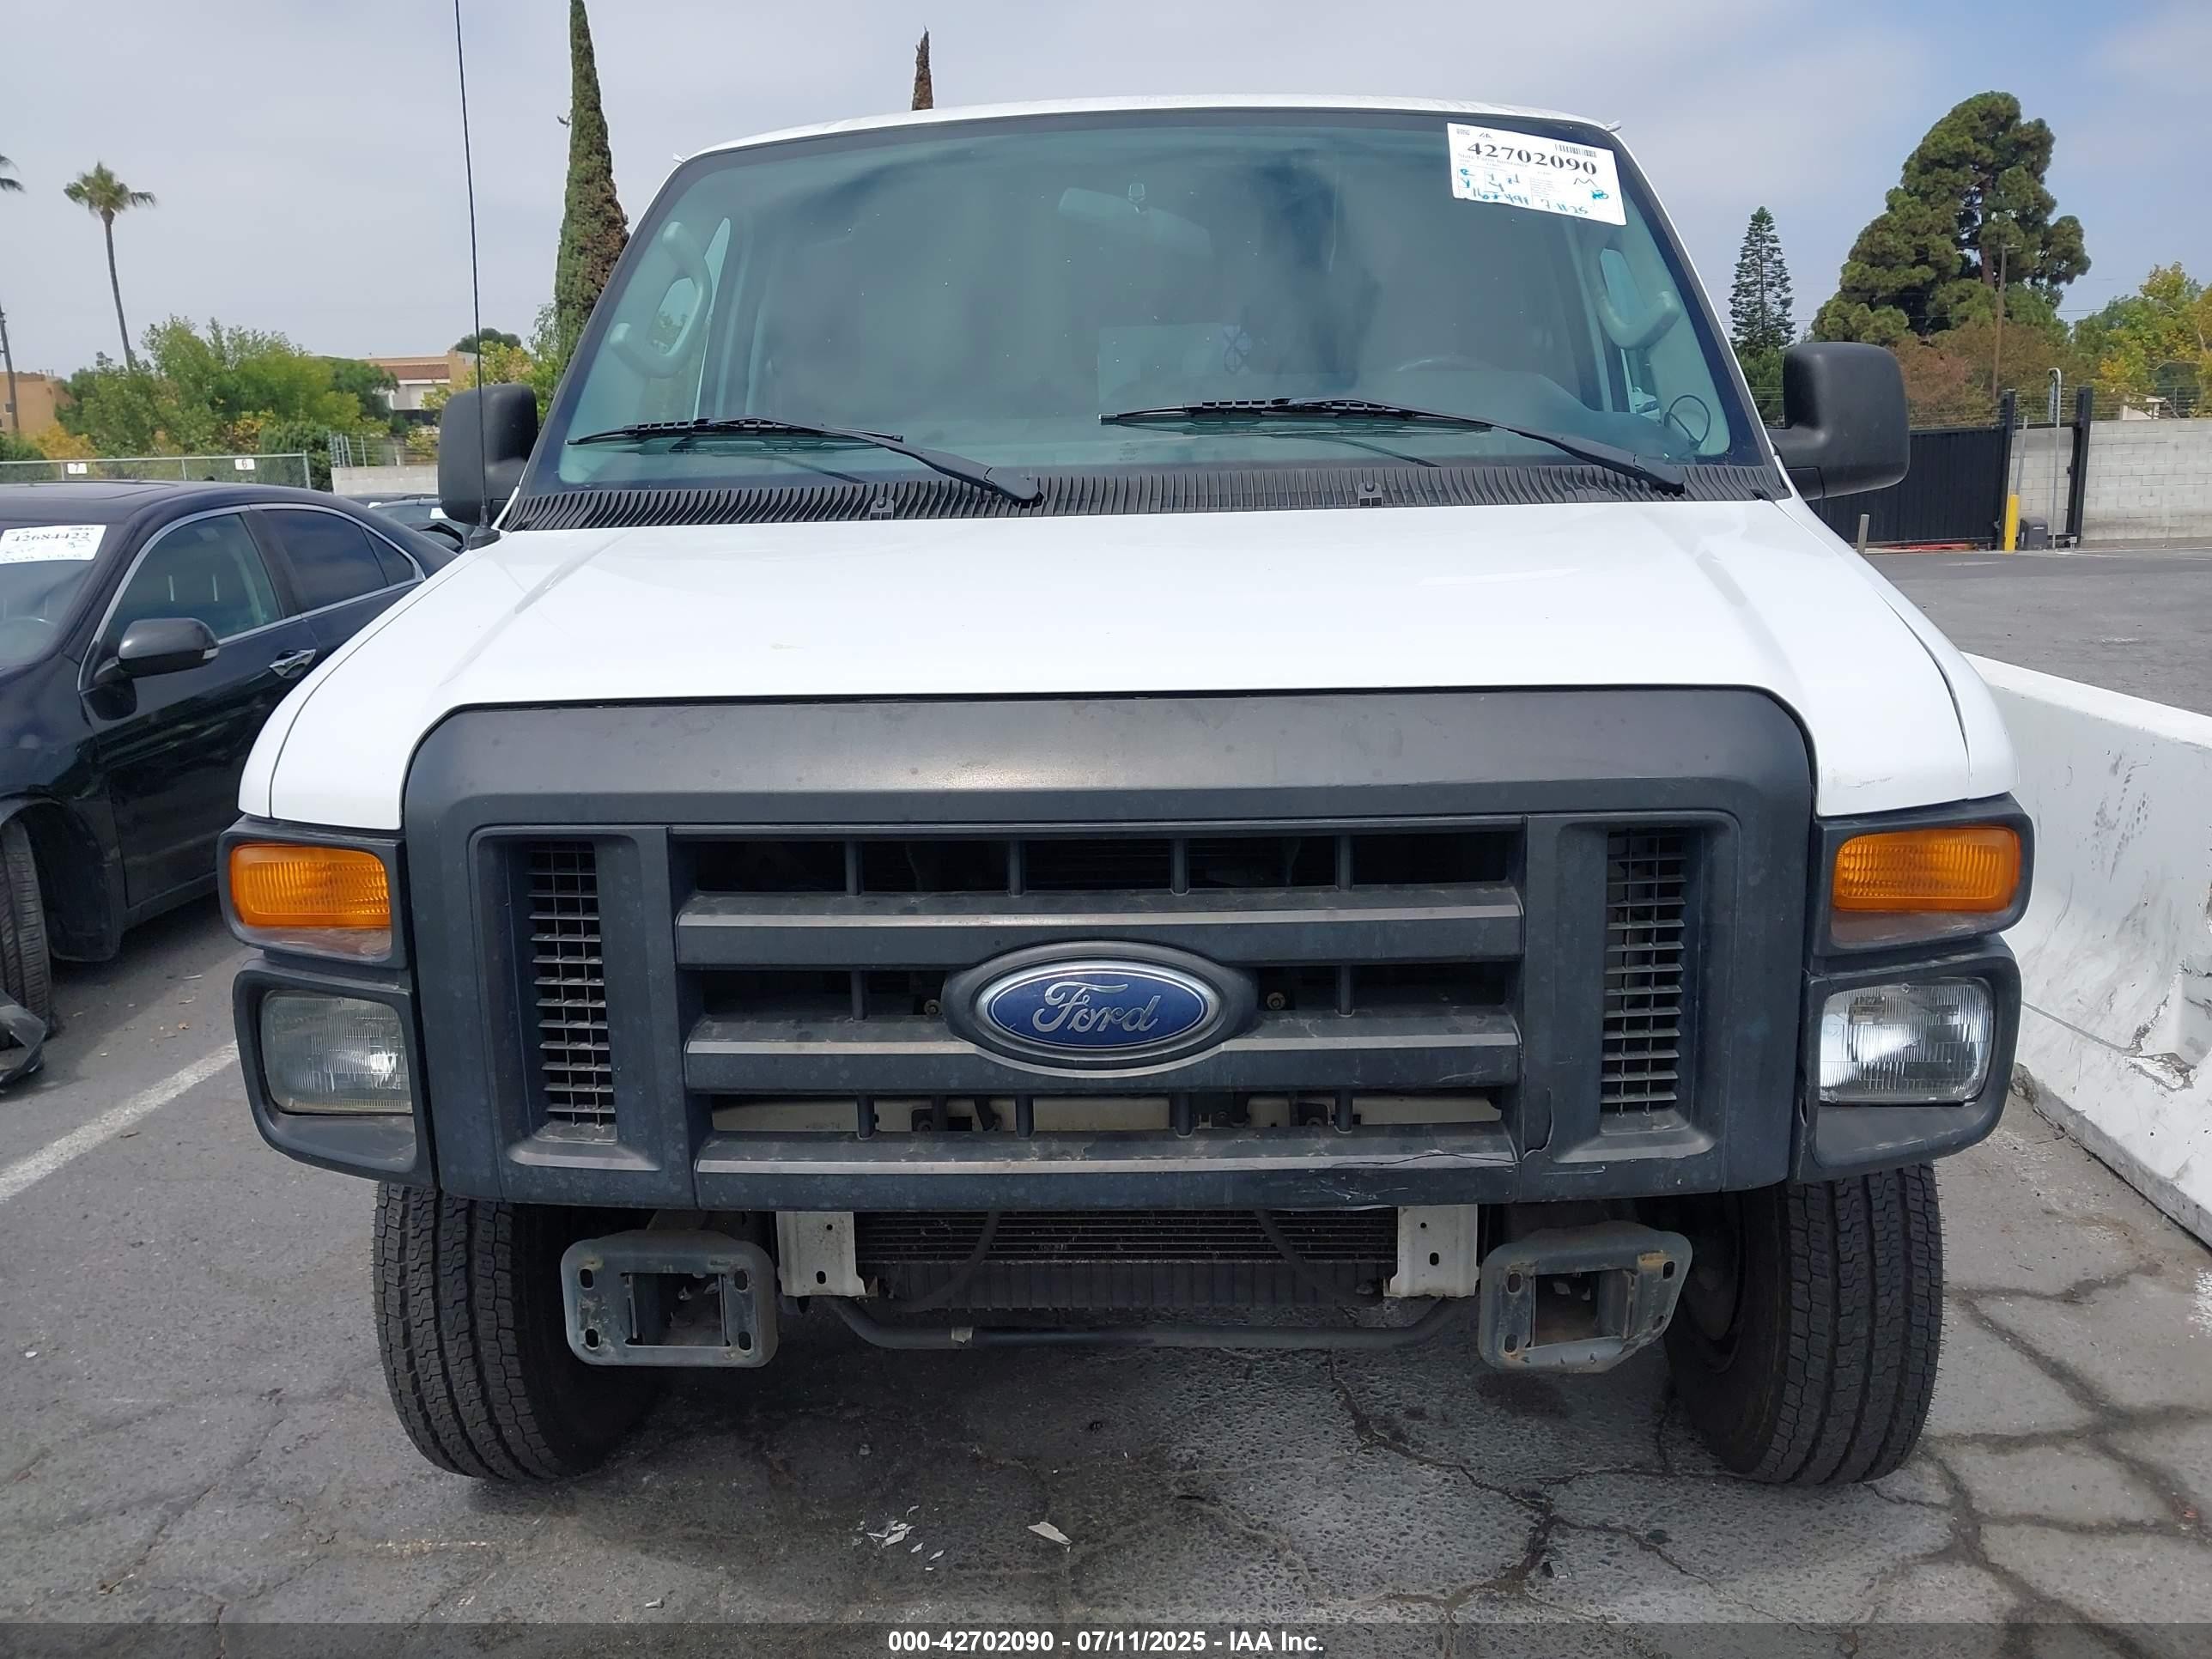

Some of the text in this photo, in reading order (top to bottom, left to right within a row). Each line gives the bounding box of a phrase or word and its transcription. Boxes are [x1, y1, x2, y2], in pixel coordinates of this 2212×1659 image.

[1467, 142, 1597, 175] 42702090
[241, 459, 248, 469] 6
[1032, 981, 1161, 1032] Ford
